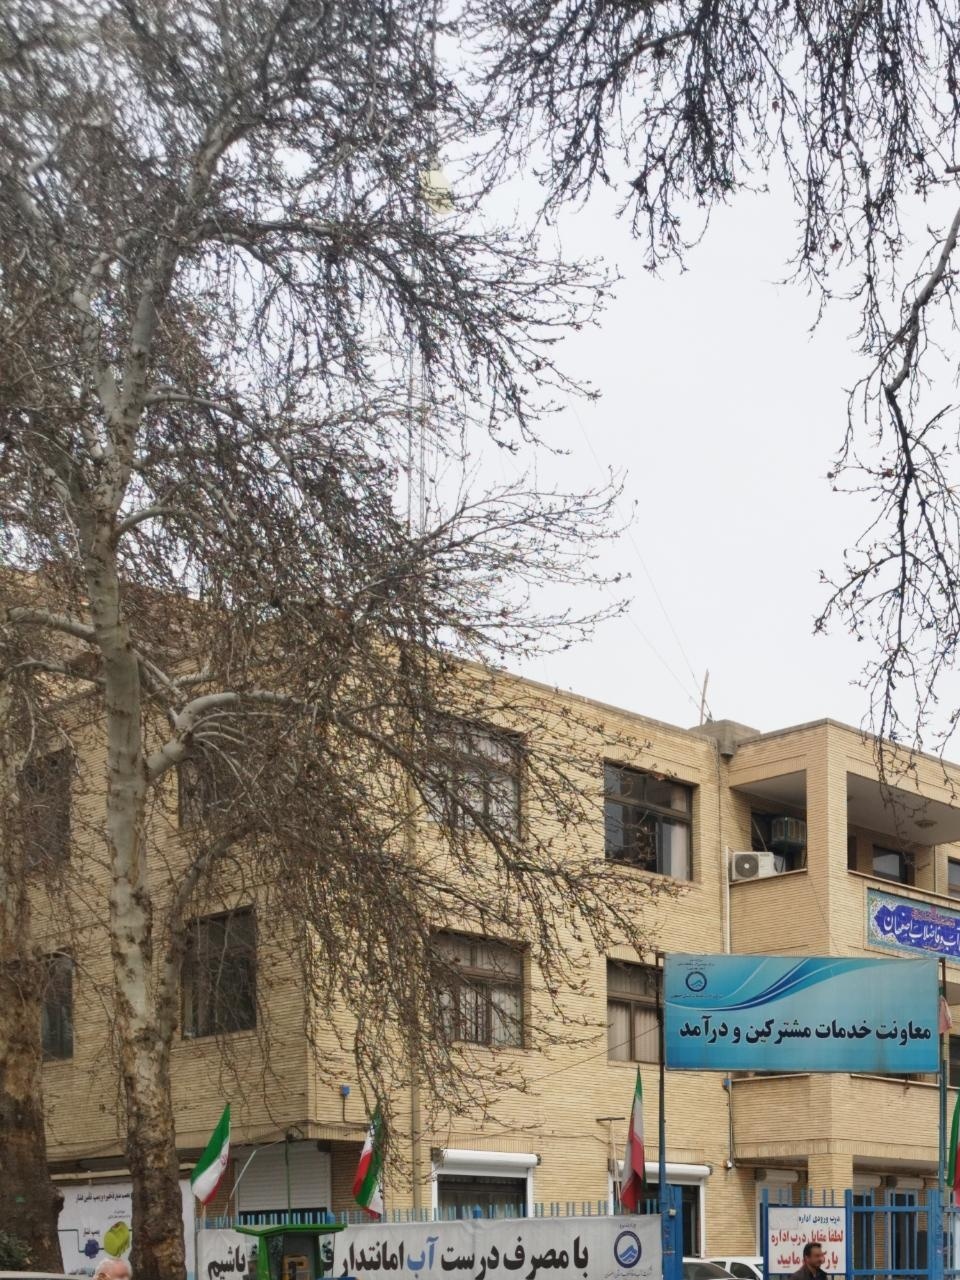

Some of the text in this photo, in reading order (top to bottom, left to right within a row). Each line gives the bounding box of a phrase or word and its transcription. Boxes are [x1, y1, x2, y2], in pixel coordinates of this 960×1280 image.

[884, 912, 913, 936] اصفهان
[679, 1015, 932, 1046] معاونت خدمات مشترکین و درآمد
[771, 1229, 789, 1246] اداره
[790, 1233, 806, 1246] درب
[807, 1228, 827, 1245] مقابل
[207, 1244, 246, 1280] باشیم
[340, 1239, 404, 1278] امانتدار
[407, 1236, 439, 1279] آب
[441, 1244, 499, 1280] درست
[503, 1236, 569, 1280] مصرف
[573, 1236, 590, 1279] با
